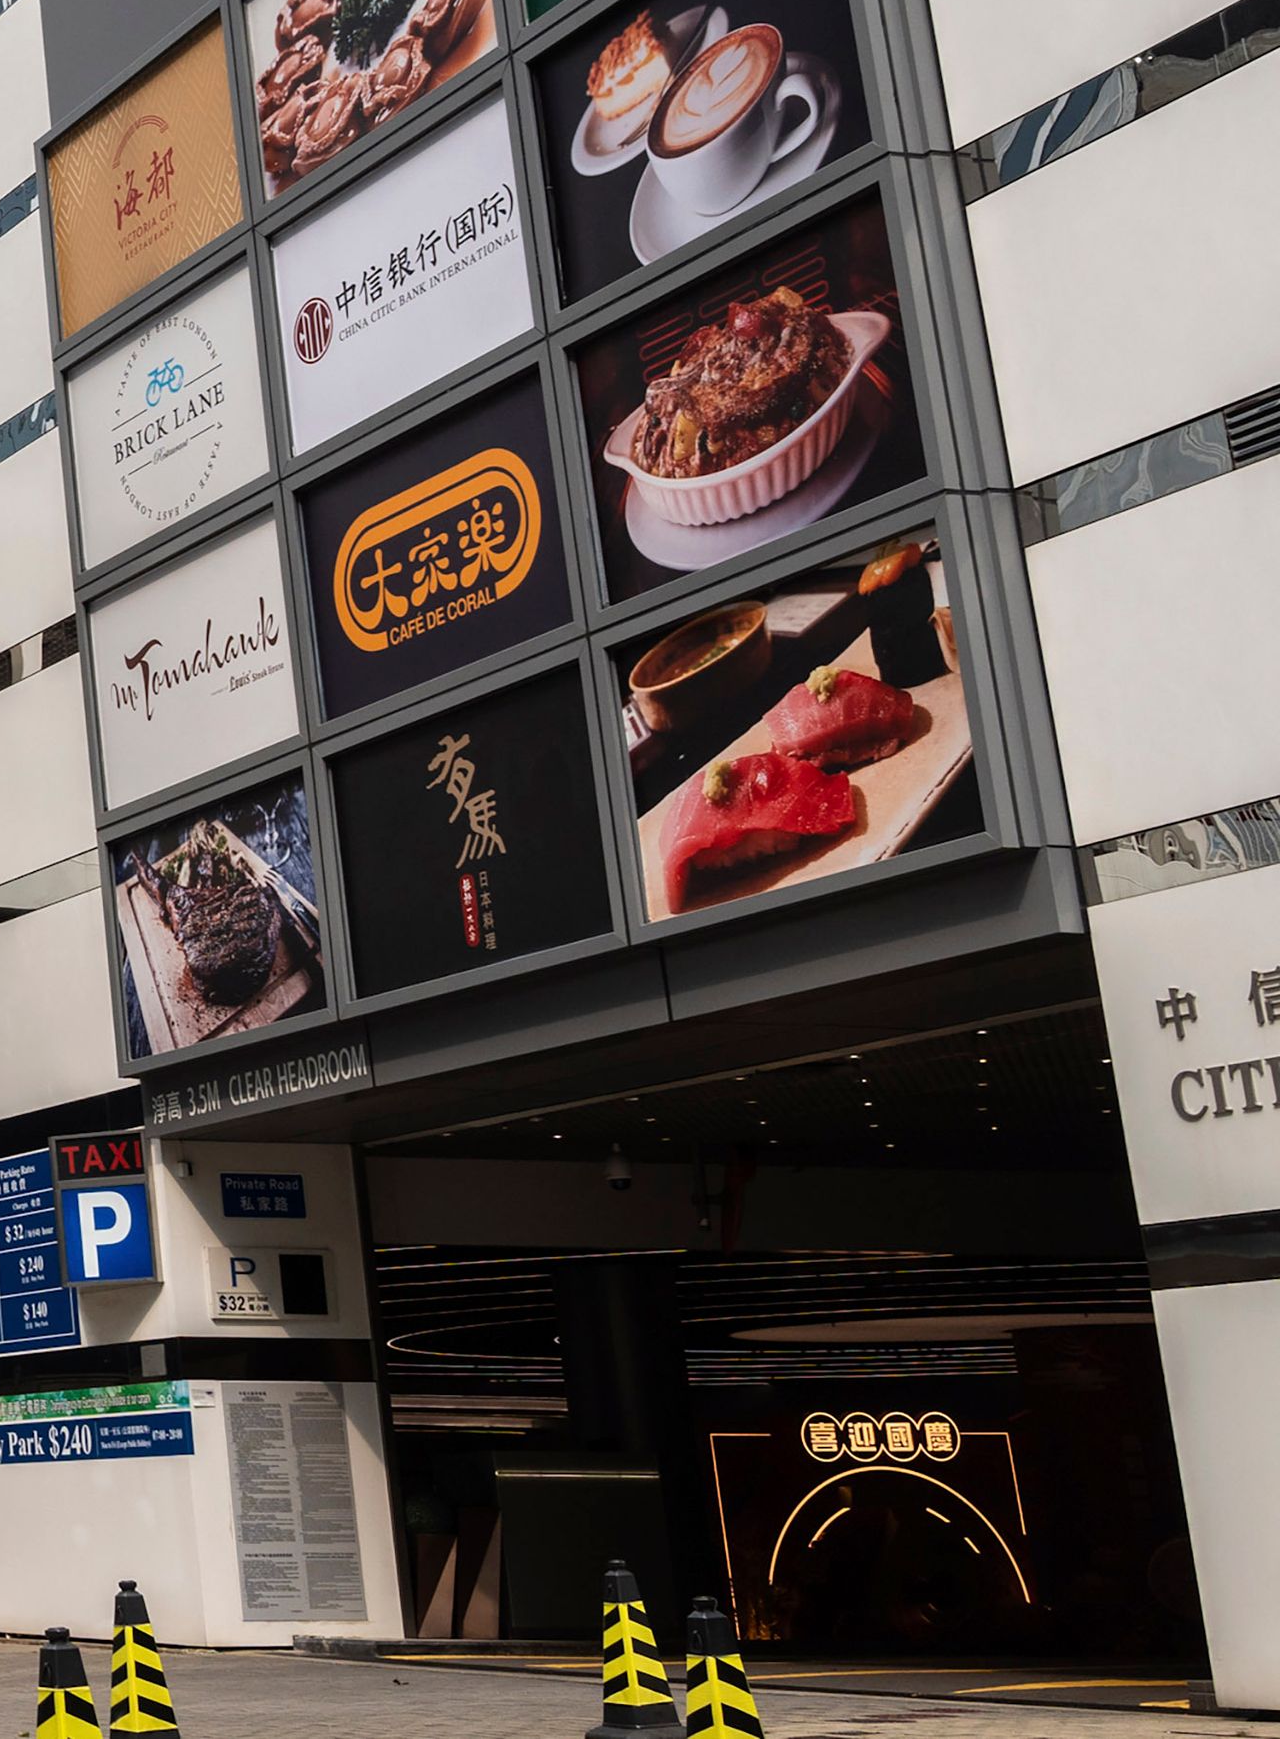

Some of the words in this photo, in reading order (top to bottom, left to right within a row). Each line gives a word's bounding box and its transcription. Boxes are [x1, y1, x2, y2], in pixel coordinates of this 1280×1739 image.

[114, 147, 174, 230] 海都
[118, 217, 157, 250] VICTORIA
[159, 201, 178, 222] CITY
[125, 221, 175, 262] RESTAURANT
[335, 183, 514, 319] 中信银行(国际)
[338, 319, 369, 342] CHINA
[370, 300, 397, 323] CITIC
[399, 282, 427, 307] BANK
[429, 228, 519, 289] INTERNATIONAL
[117, 352, 138, 399] TASTE
[140, 333, 151, 348] OF
[154, 316, 179, 334] EAST
[182, 317, 219, 361] LONDON
[113, 415, 169, 465] BRICK
[173, 381, 225, 435] LANE
[198, 441, 221, 489] TASTE
[120, 475, 153, 521] LONDON
[156, 505, 181, 521] EAST
[183, 492, 197, 509] OF
[389, 610, 425, 646] CAFÉ
[426, 606, 446, 629] DE
[446, 587, 496, 621] CORAL
[124, 596, 280, 721] Tomahawk
[426, 733, 507, 870] 有馬
[479, 870, 497, 951] 日本料理
[151, 1092, 183, 1126] 淨高
[188, 1079, 222, 1116] 3.5M
[228, 1064, 275, 1109] CLEAR
[277, 1047, 369, 1095] HEADROOM
[60, 1139, 142, 1175] TAXI
[225, 1177, 267, 1190] Private
[269, 1178, 300, 1191] Road
[239, 1195, 289, 1212] 私家路
[76, 1190, 132, 1279] P
[230, 1257, 256, 1288] P
[218, 1295, 246, 1312] $32
[7, 1427, 46, 1457] Park
[48, 1423, 92, 1459] $240
[807, 1419, 956, 1455] 喜迎國慶
